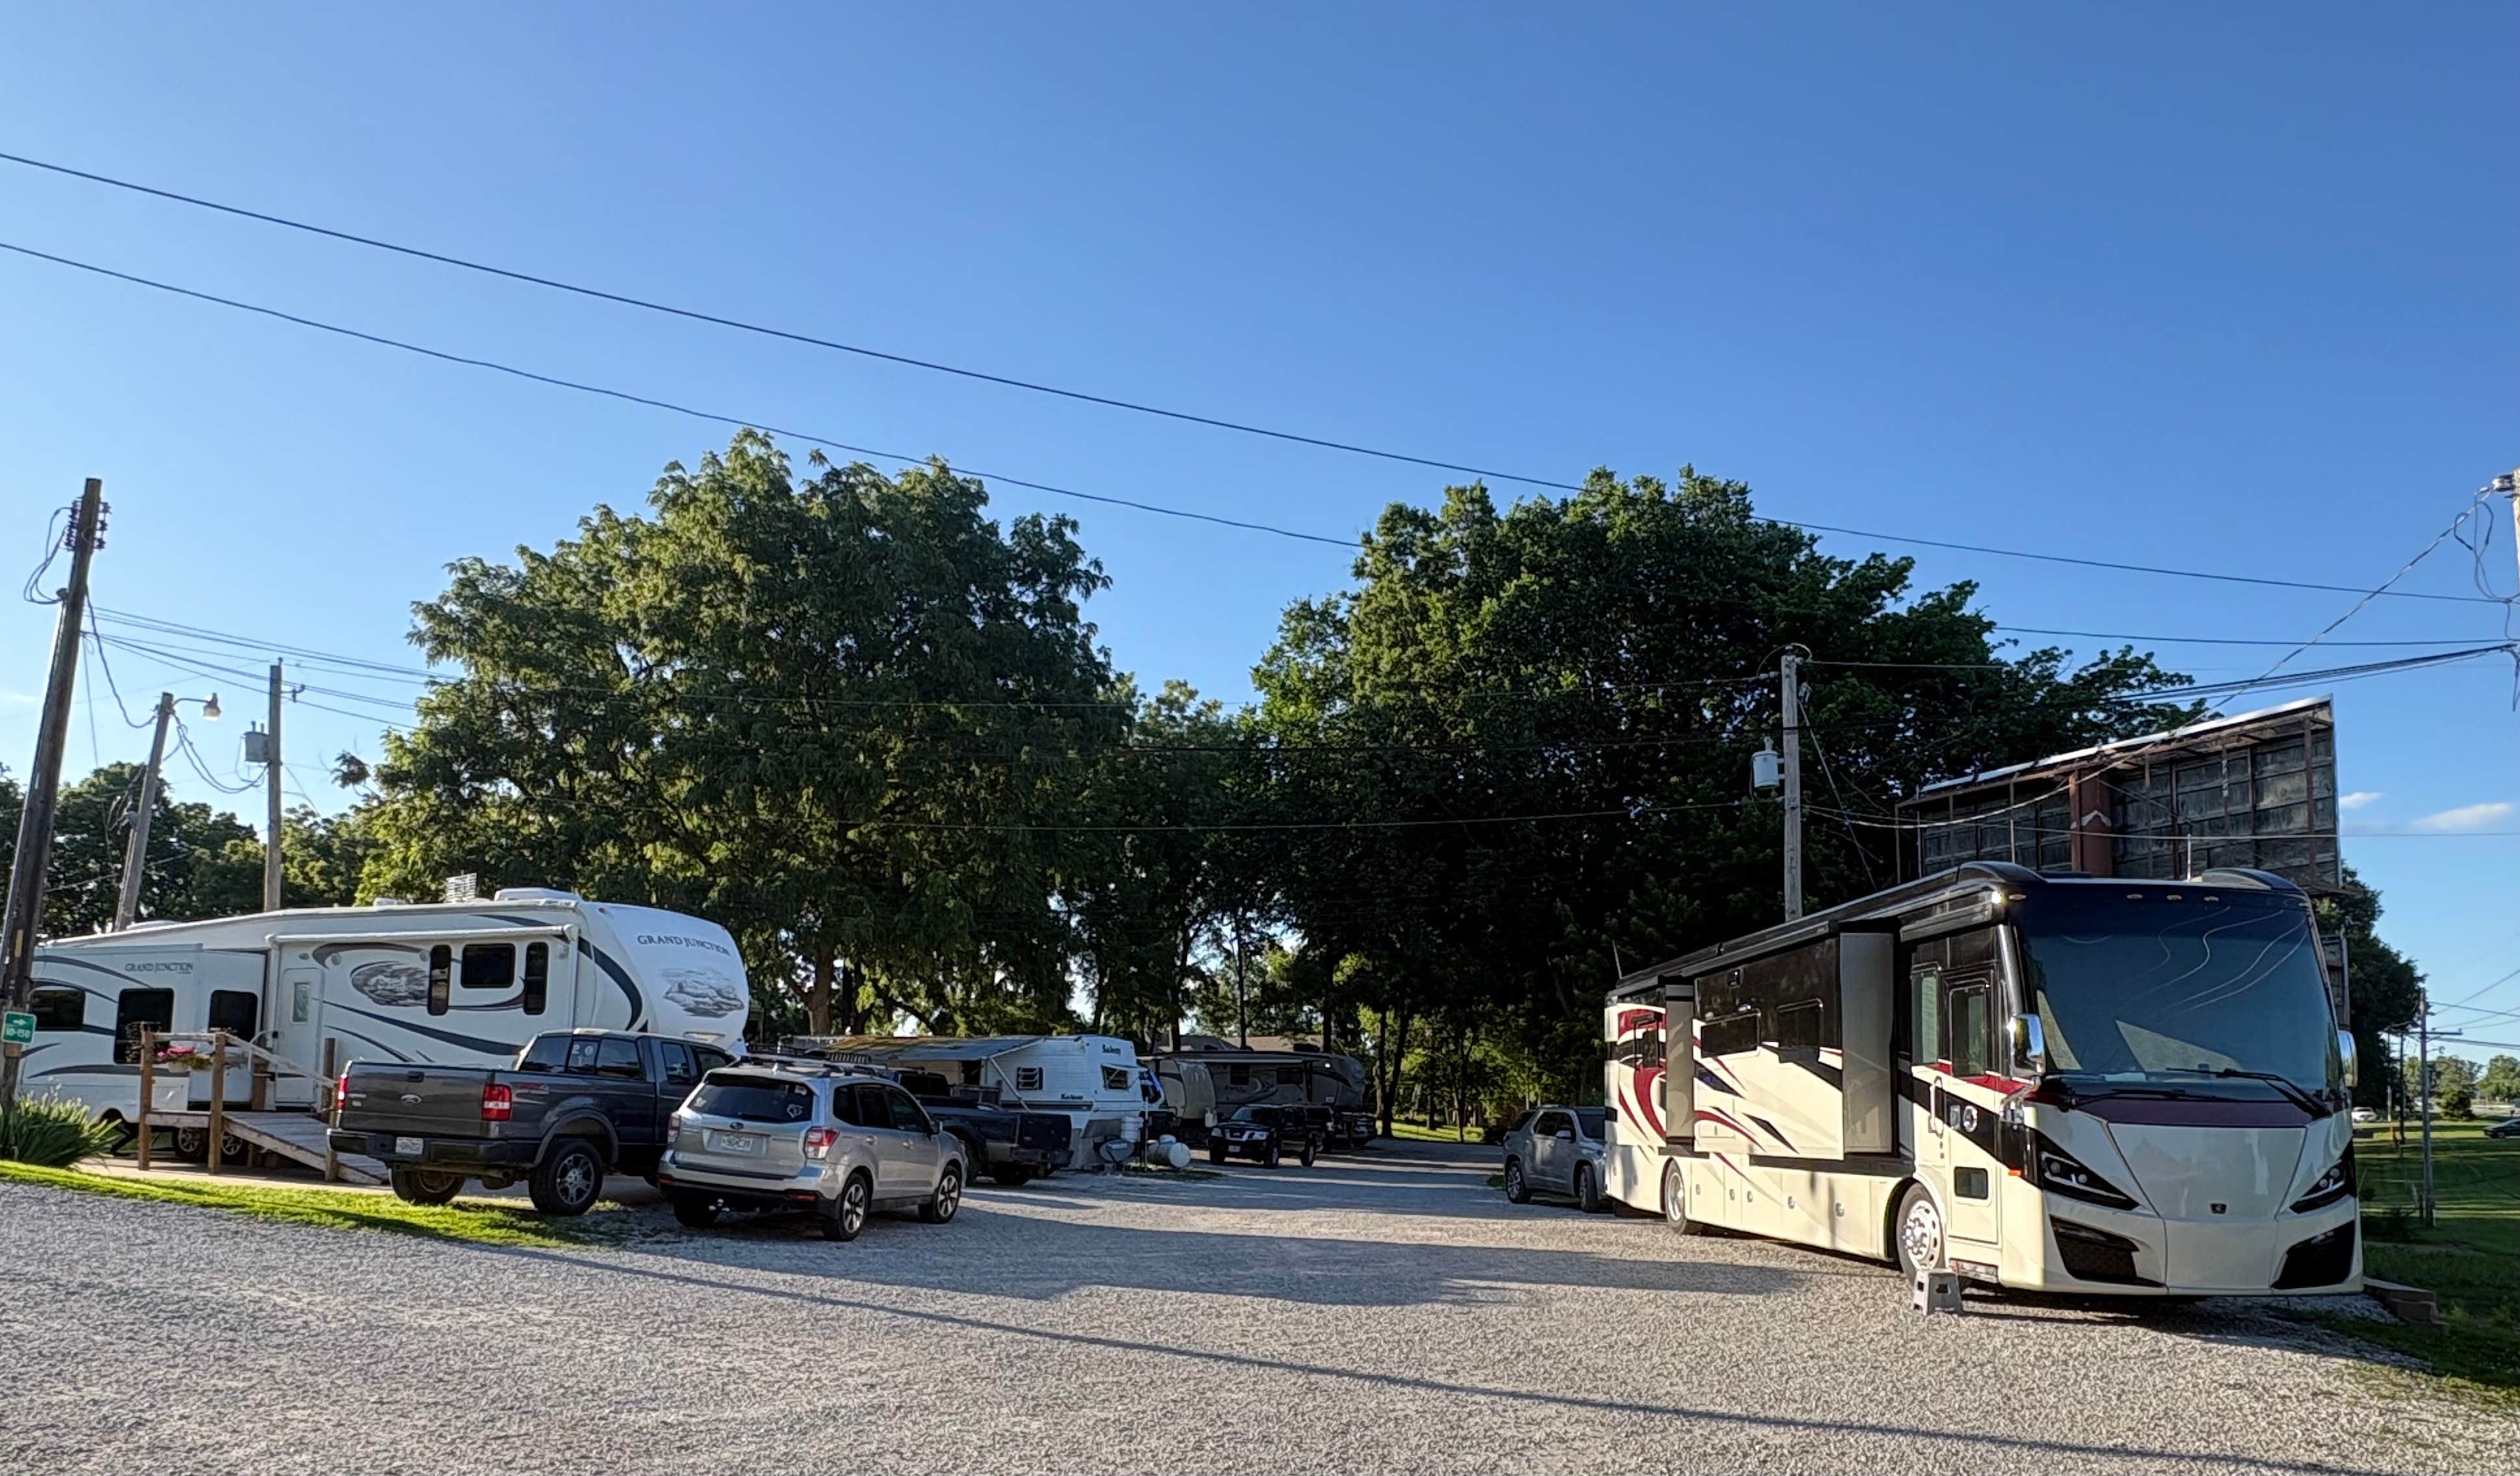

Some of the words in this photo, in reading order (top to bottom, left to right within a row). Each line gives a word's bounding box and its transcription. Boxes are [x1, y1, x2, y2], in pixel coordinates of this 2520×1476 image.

[637, 935, 683, 945] GRAND
[683, 937, 731, 957] JUNCTION
[125, 963, 154, 972] GRAND
